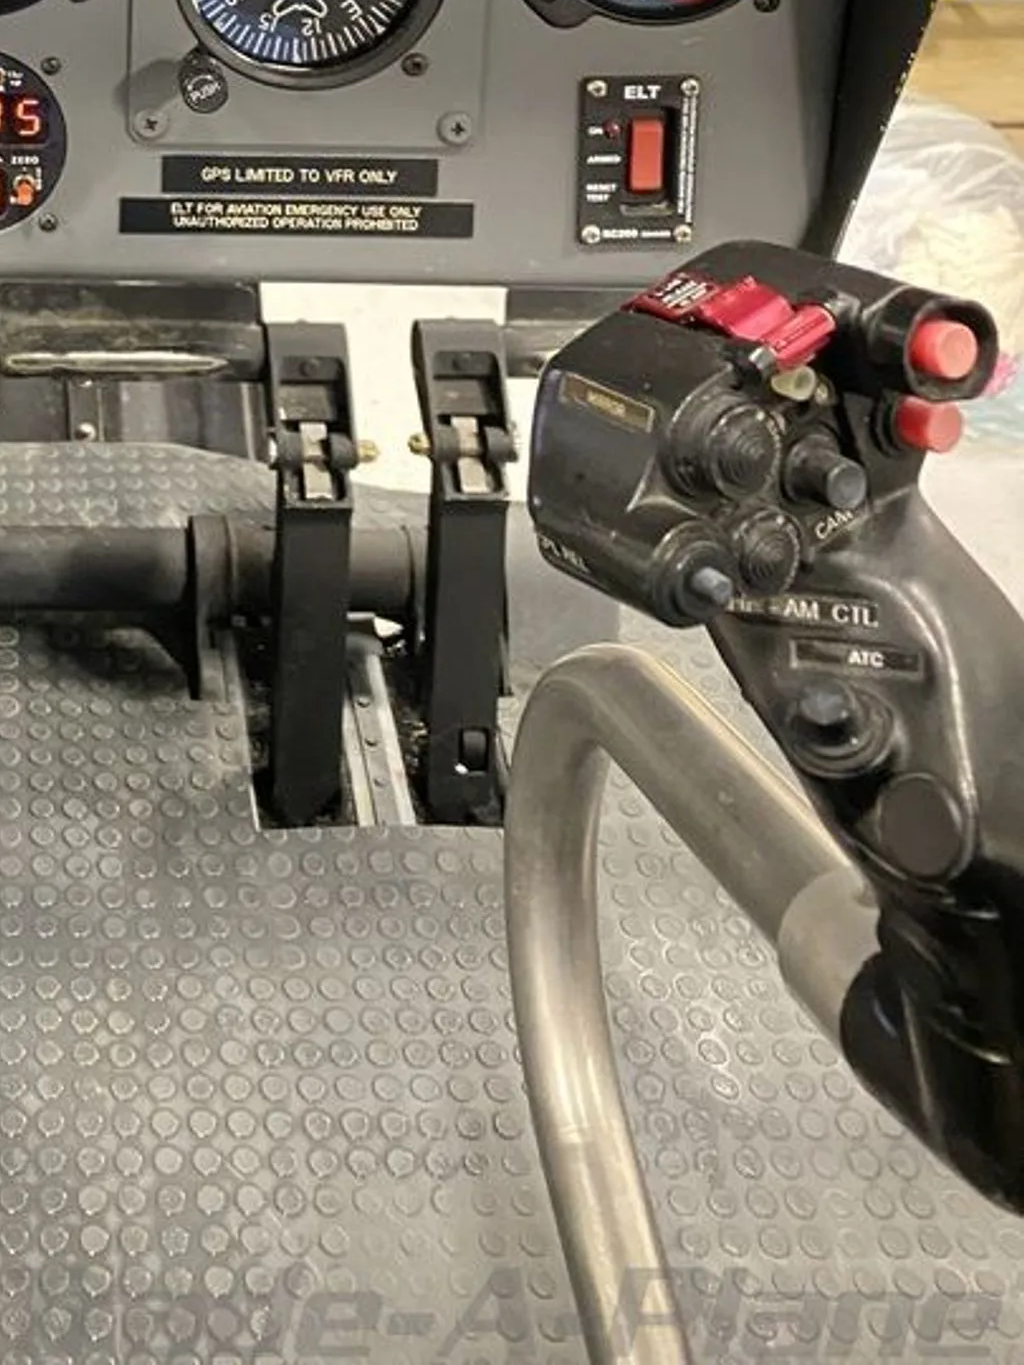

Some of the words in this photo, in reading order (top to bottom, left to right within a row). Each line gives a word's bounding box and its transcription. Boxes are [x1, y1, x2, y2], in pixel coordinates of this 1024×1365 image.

[624, 85, 662, 100] ELT
[201, 167, 231, 183] GPS
[235, 168, 294, 183] LIMITED
[300, 169, 320, 183] TO
[325, 169, 356, 183] VFR
[360, 169, 398, 184] ONLY
[197, 203, 224, 216] FOR
[226, 203, 282, 216] AVIATION
[285, 204, 358, 217] EMERGENCY
[361, 205, 387, 217] USE
[389, 205, 423, 218] ONLY
[173, 216, 269, 230] UNAUTHORIZED
[272, 217, 342, 231] OPERATION
[345, 218, 419, 231] PROHIBITED
[847, 650, 885, 667] ATC
